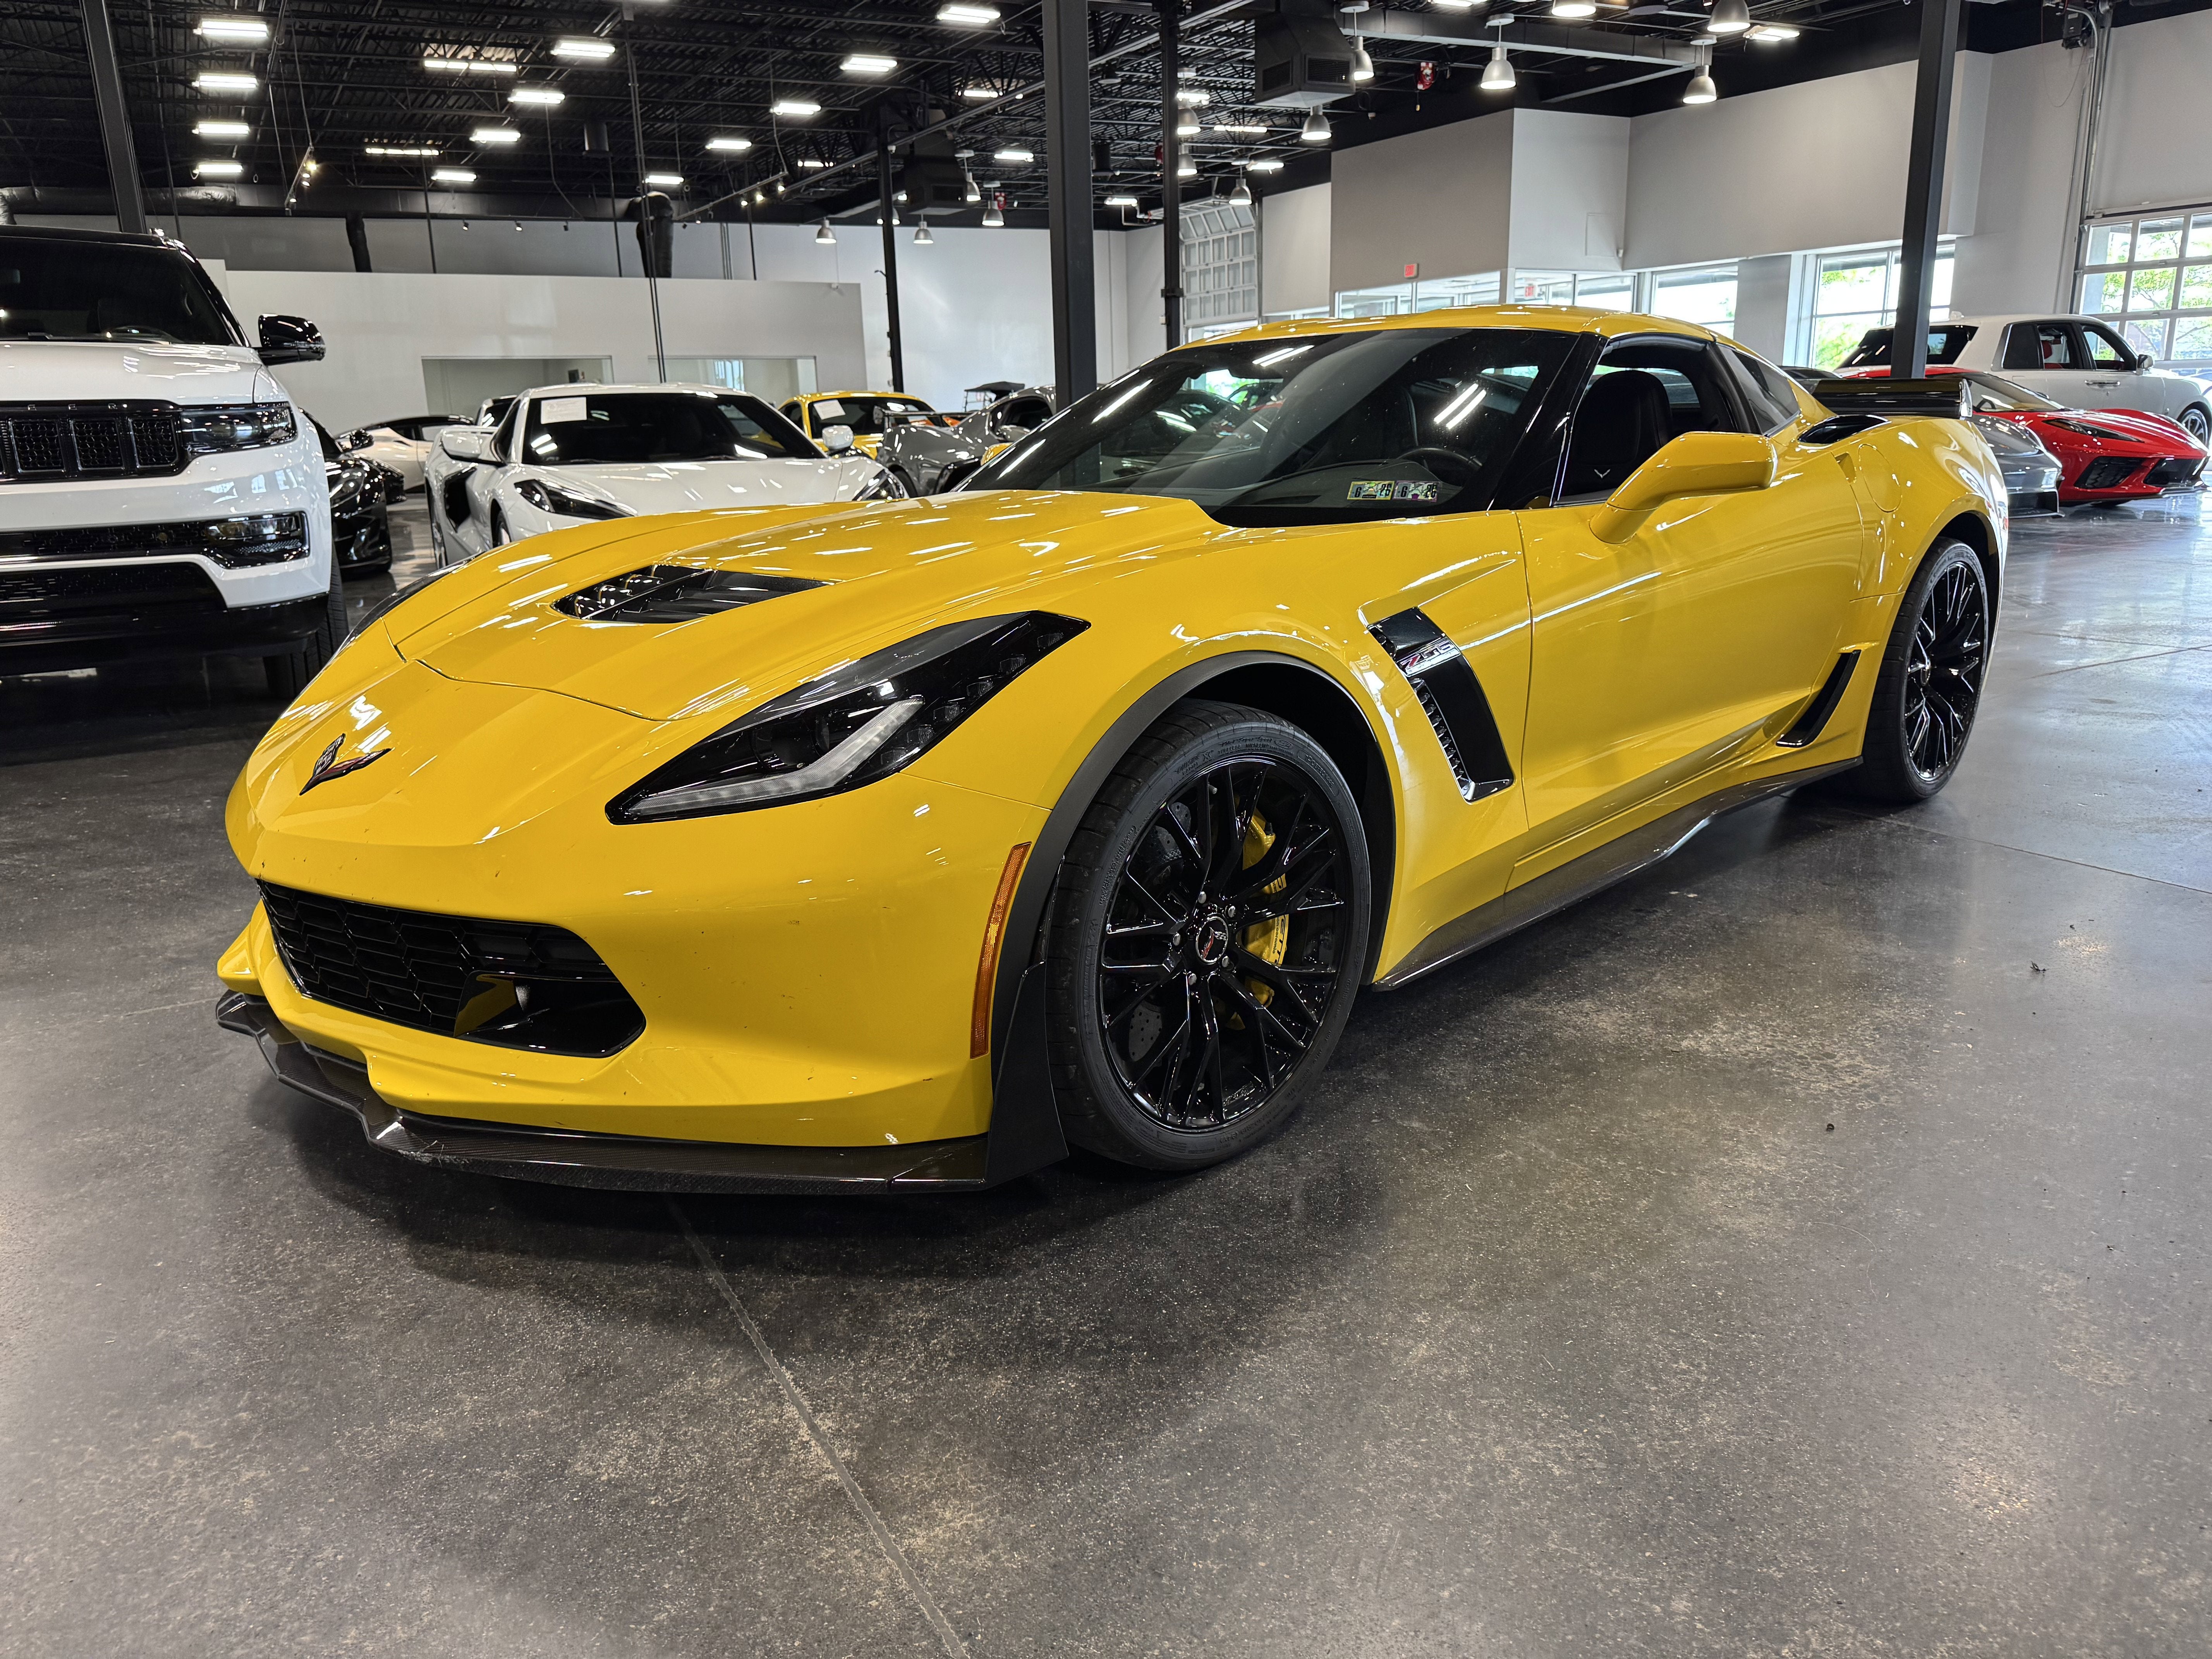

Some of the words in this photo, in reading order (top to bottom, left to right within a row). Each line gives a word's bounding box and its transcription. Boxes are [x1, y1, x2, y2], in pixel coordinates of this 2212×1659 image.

[1355, 487, 1362, 498] 6
[1379, 483, 1392, 496] 26
[1400, 486, 1408, 497] 6
